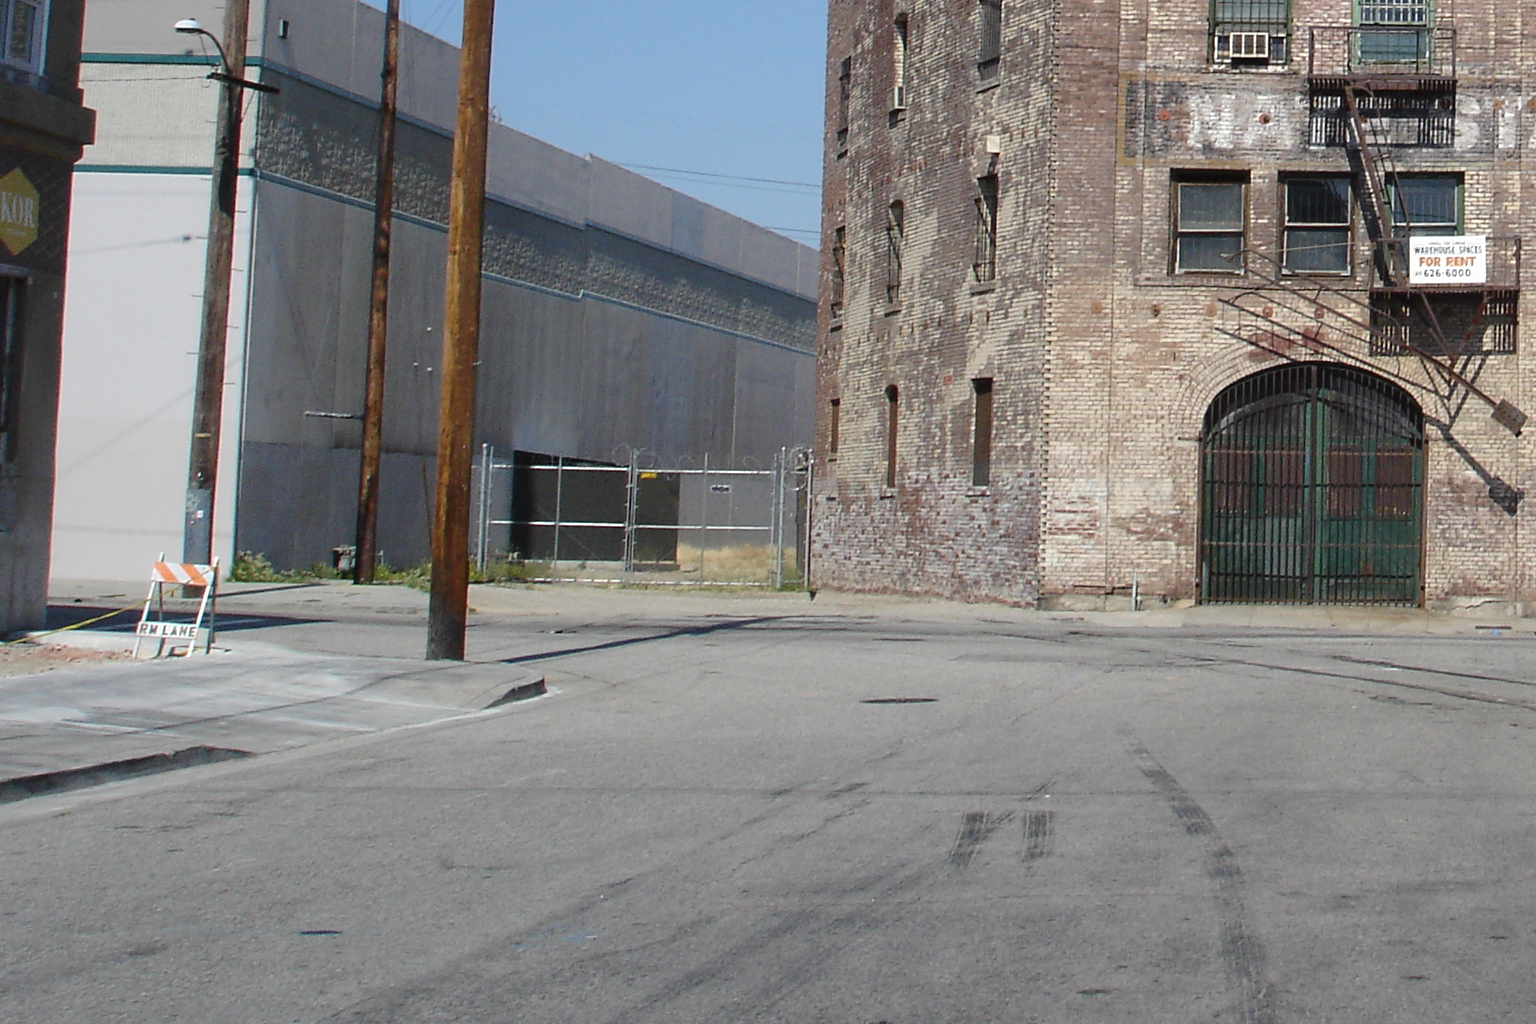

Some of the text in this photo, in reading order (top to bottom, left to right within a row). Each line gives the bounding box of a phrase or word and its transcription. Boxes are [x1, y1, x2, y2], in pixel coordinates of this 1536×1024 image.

[1, 191, 35, 228] KOR
[1414, 245, 1482, 255] WAREHOUSE SPACES
[1419, 256, 1477, 267] FOR RENT
[162, 625, 197, 636] LANE
